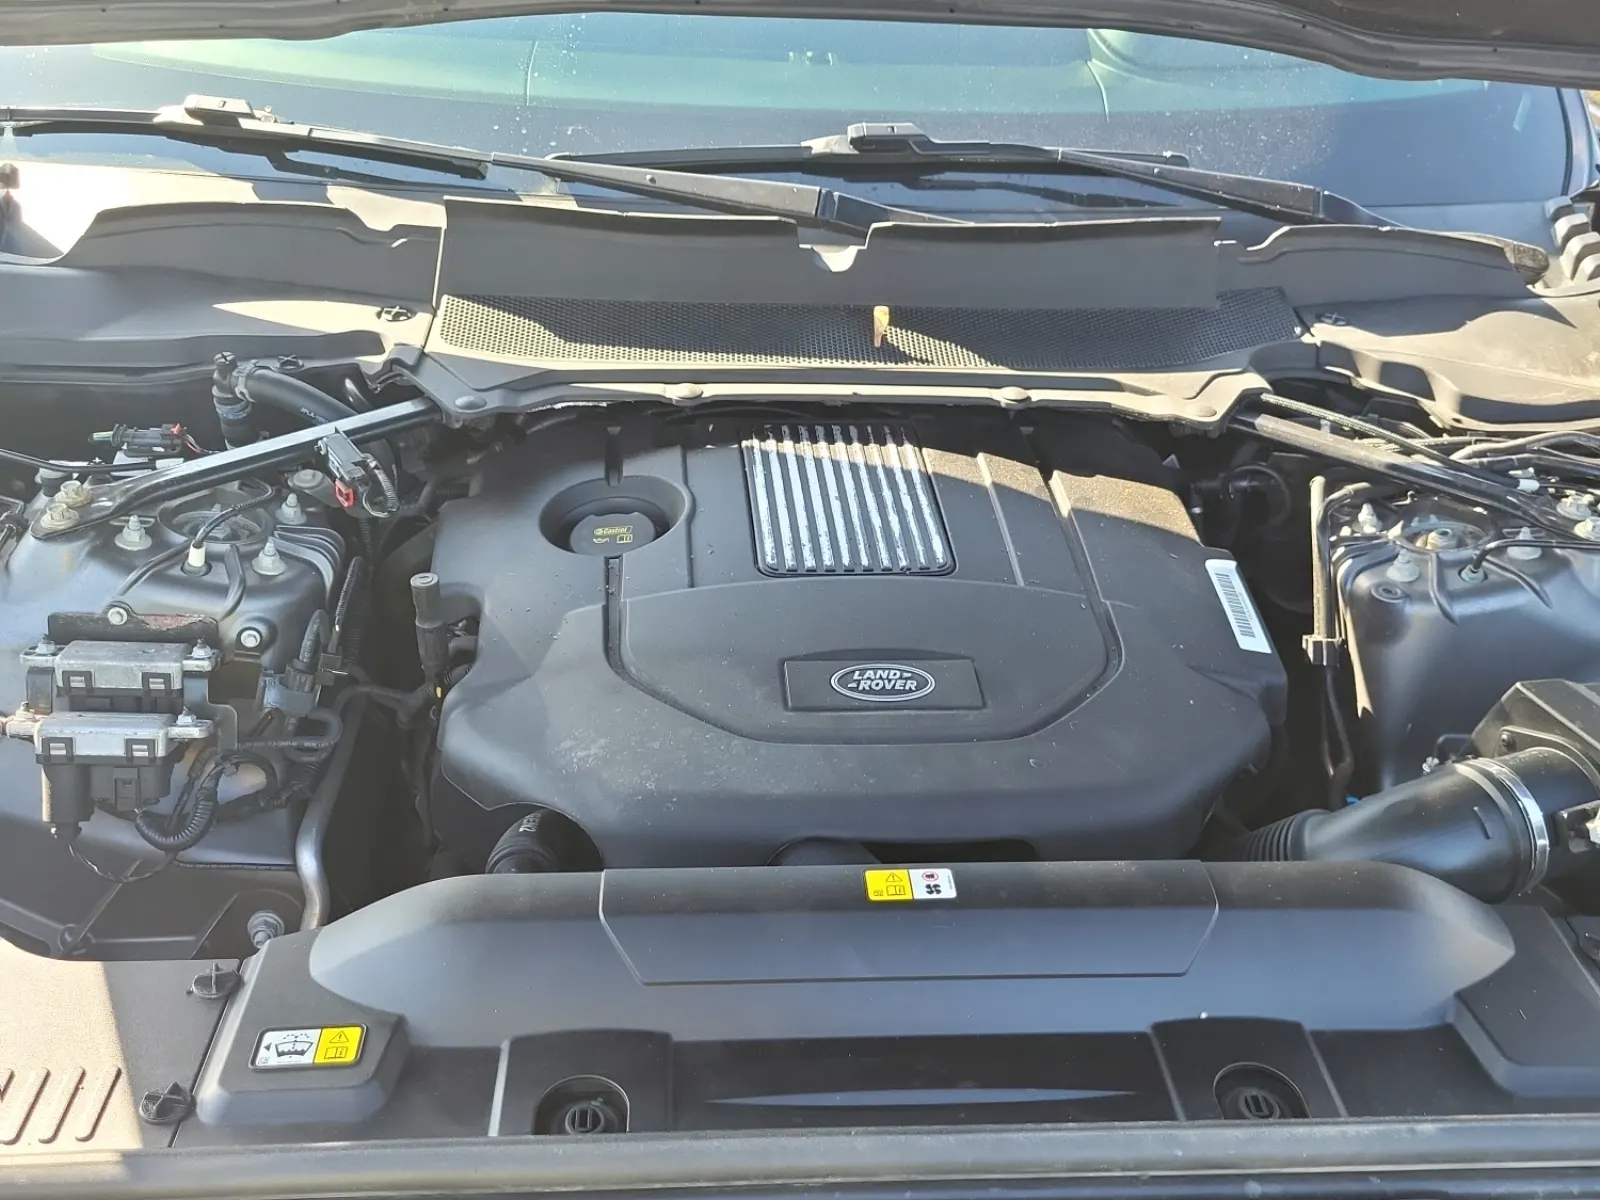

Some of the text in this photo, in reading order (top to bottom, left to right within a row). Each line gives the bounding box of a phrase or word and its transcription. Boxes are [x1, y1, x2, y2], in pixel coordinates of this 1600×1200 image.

[603, 526, 627, 534] Castrol
[853, 669, 901, 680] LAND
[858, 679, 917, 691] ROVER
